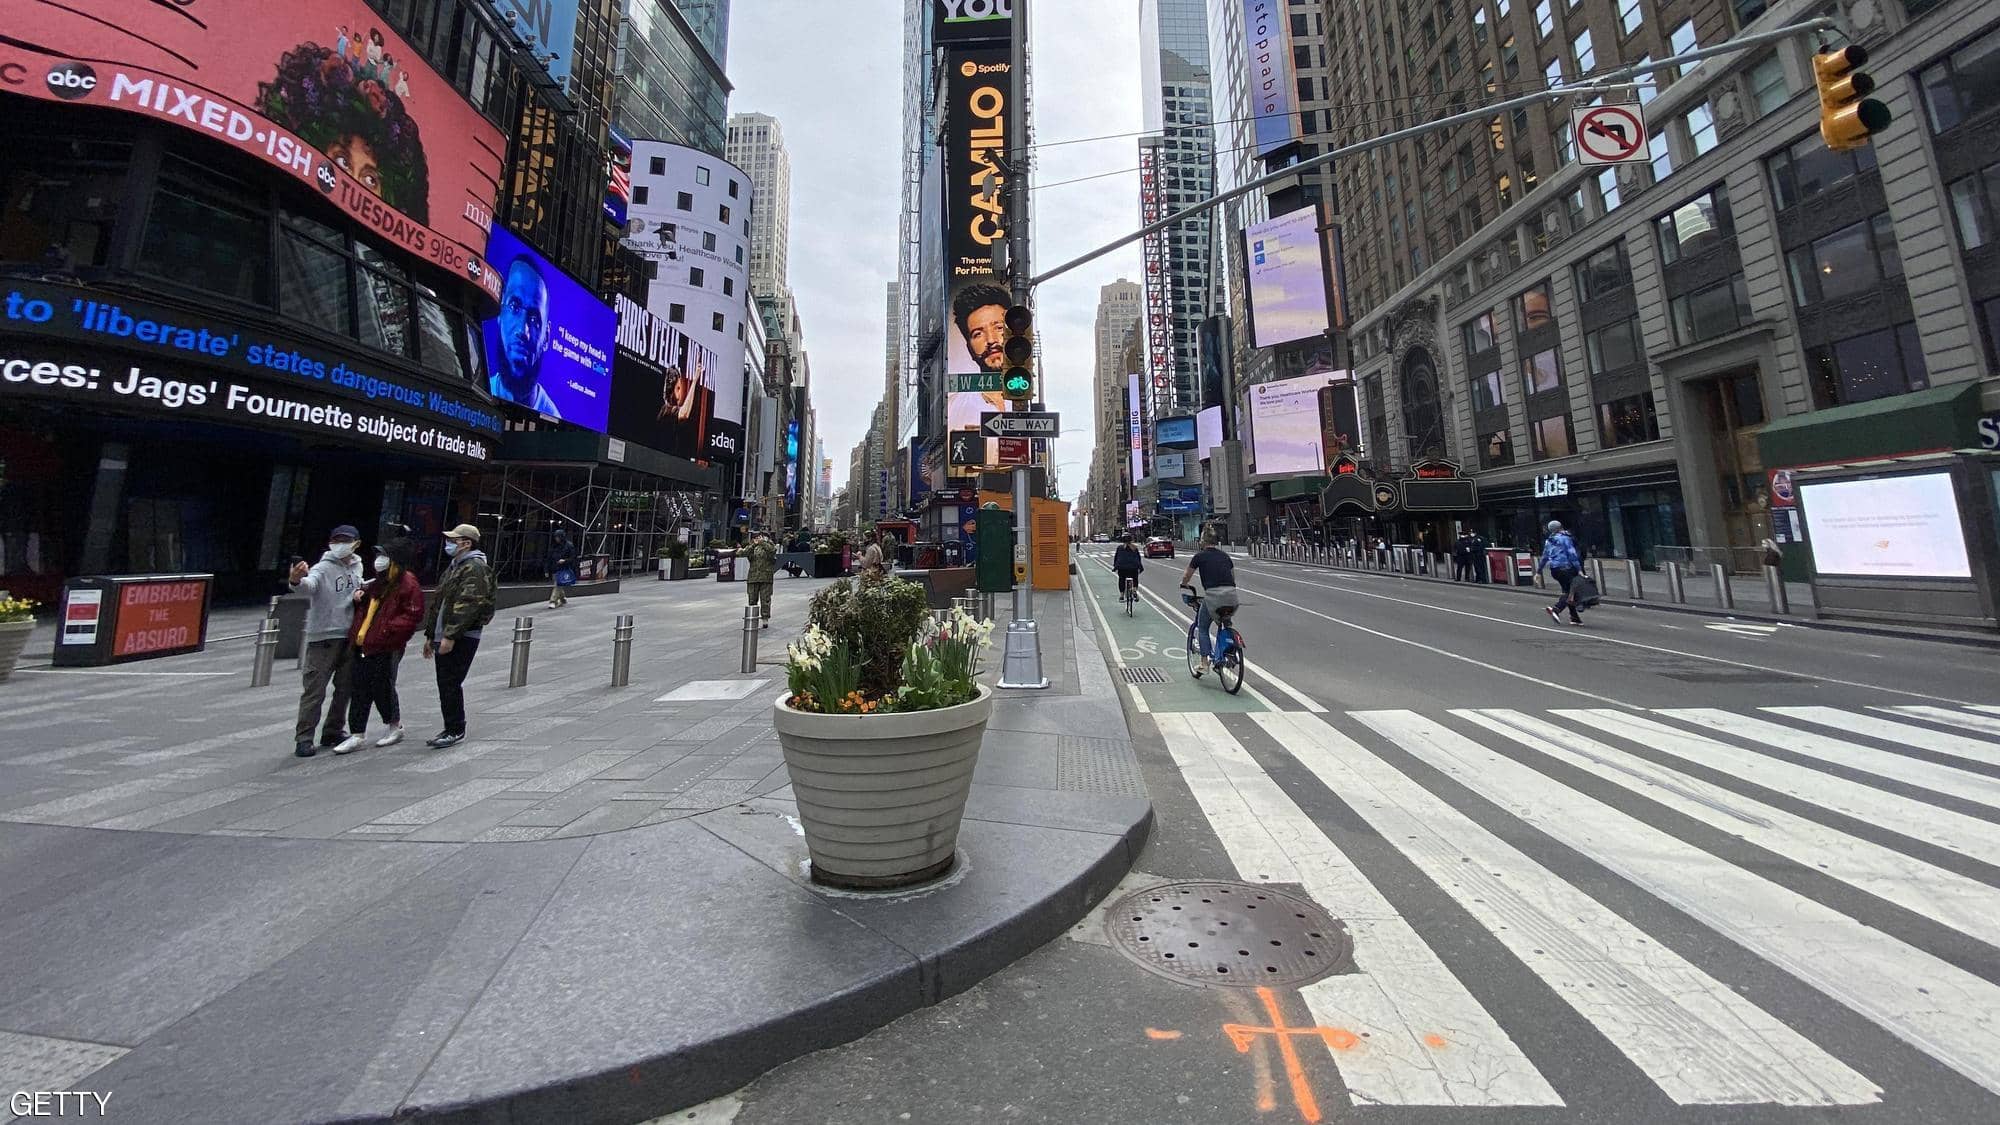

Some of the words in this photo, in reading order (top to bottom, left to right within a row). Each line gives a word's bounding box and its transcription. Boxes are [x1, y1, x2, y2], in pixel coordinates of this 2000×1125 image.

[978, 62, 1010, 74] Spotify
[1255, 2, 1277, 113] stoppable
[47, 69, 96, 89] abc
[317, 166, 337, 188] abc
[340, 179, 426, 251] TUESDAYS
[467, 260, 482, 276] abc
[970, 86, 1004, 245] CAMILO
[955, 266, 970, 275] Por
[614, 292, 649, 357] CHRIS
[6, 291, 54, 323] to
[72, 298, 239, 357] 'liberate'
[247, 343, 326, 380] states
[331, 363, 425, 408] dangerous:
[552, 339, 563, 352] the
[563, 347, 580, 362] game
[565, 330, 580, 348] keep
[579, 340, 589, 353] my
[961, 376, 972, 390] W
[978, 376, 994, 389] 44
[113, 367, 218, 408] Jags'
[226, 384, 353, 429] Fournette
[356, 415, 418, 442] subject
[420, 428, 435, 446] of
[436, 431, 466, 454] trade
[467, 439, 487, 461] talks
[992, 419, 1015, 430] ONE
[1025, 419, 1049, 430] WAY
[1131, 410, 1139, 425] BIG
[711, 431, 735, 454] sdaq
[1978, 417, 2000, 449] S
[1535, 473, 1568, 498] Lids
[125, 583, 199, 606] EMBRACE
[149, 608, 170, 622] THE
[123, 626, 189, 653] ABSURD
